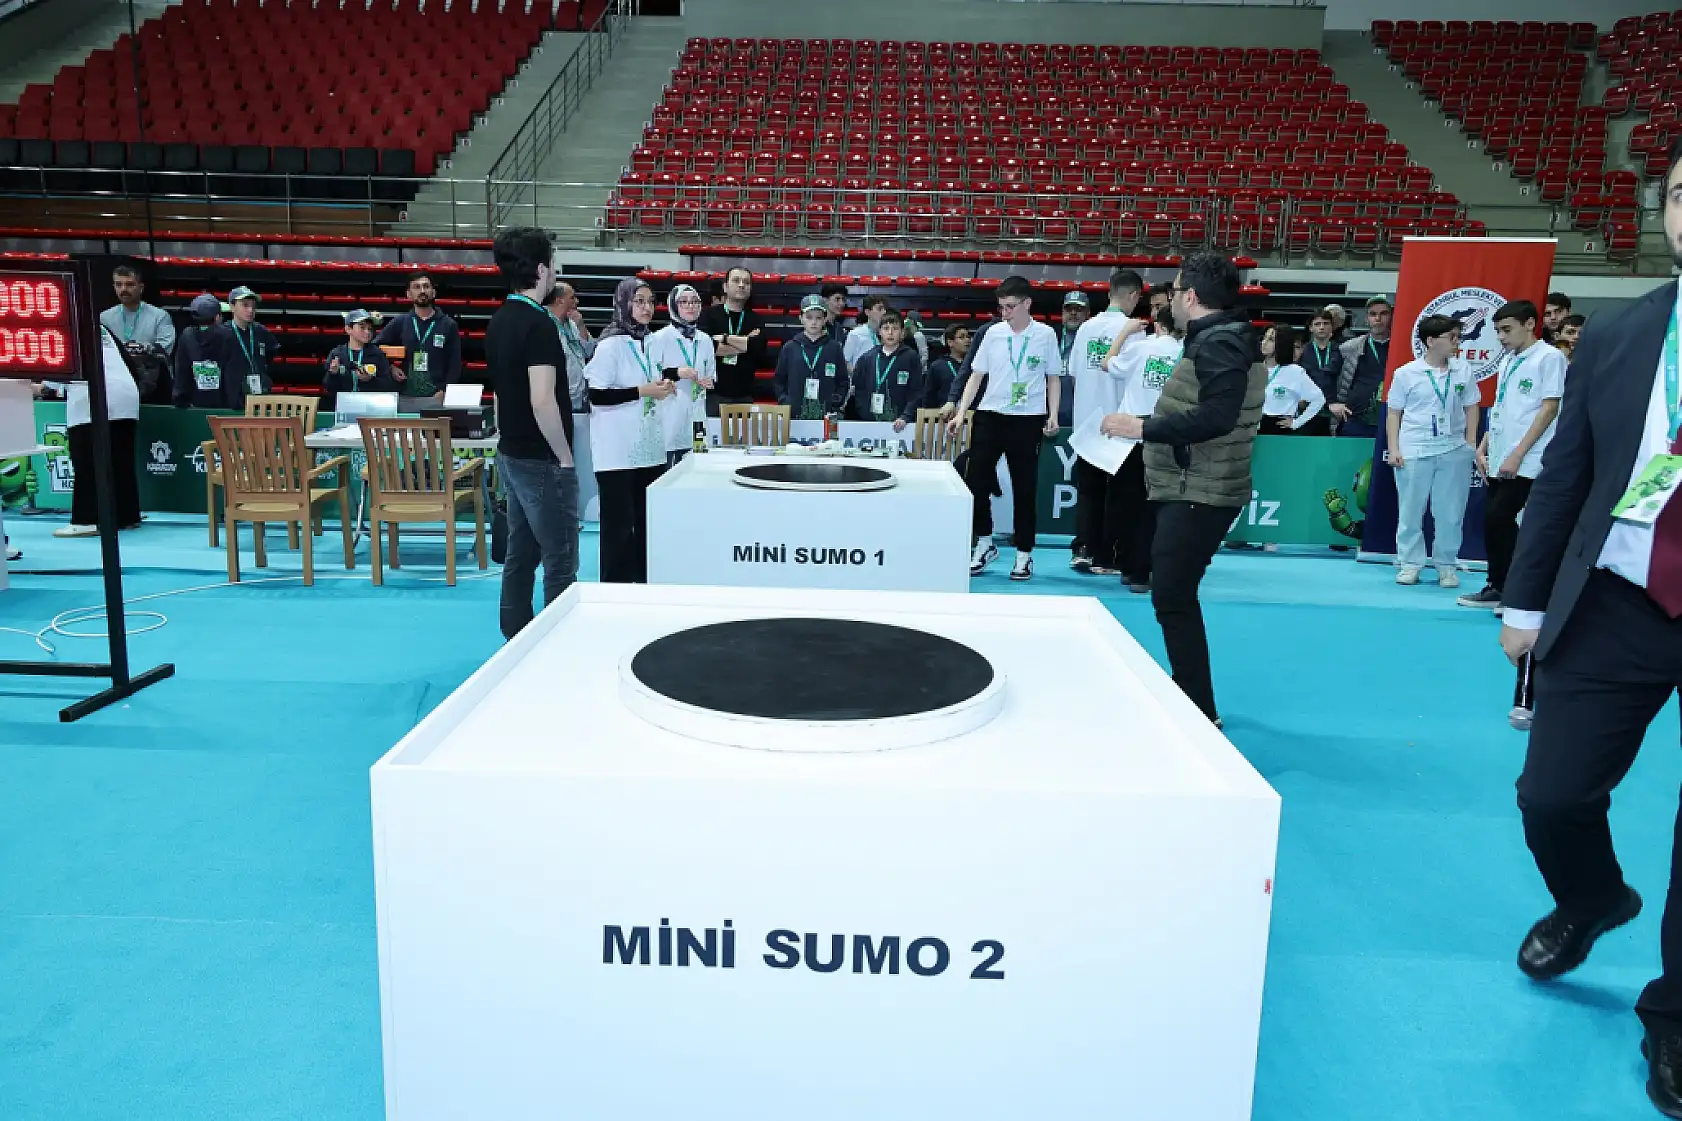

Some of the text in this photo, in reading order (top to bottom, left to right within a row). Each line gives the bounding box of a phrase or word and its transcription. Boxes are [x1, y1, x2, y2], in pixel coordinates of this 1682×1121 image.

[1456, 349, 1489, 360] TEK
[733, 542, 884, 566] MİNİ SUMO 1
[602, 917, 1005, 979] MİNİ SUMO 2
